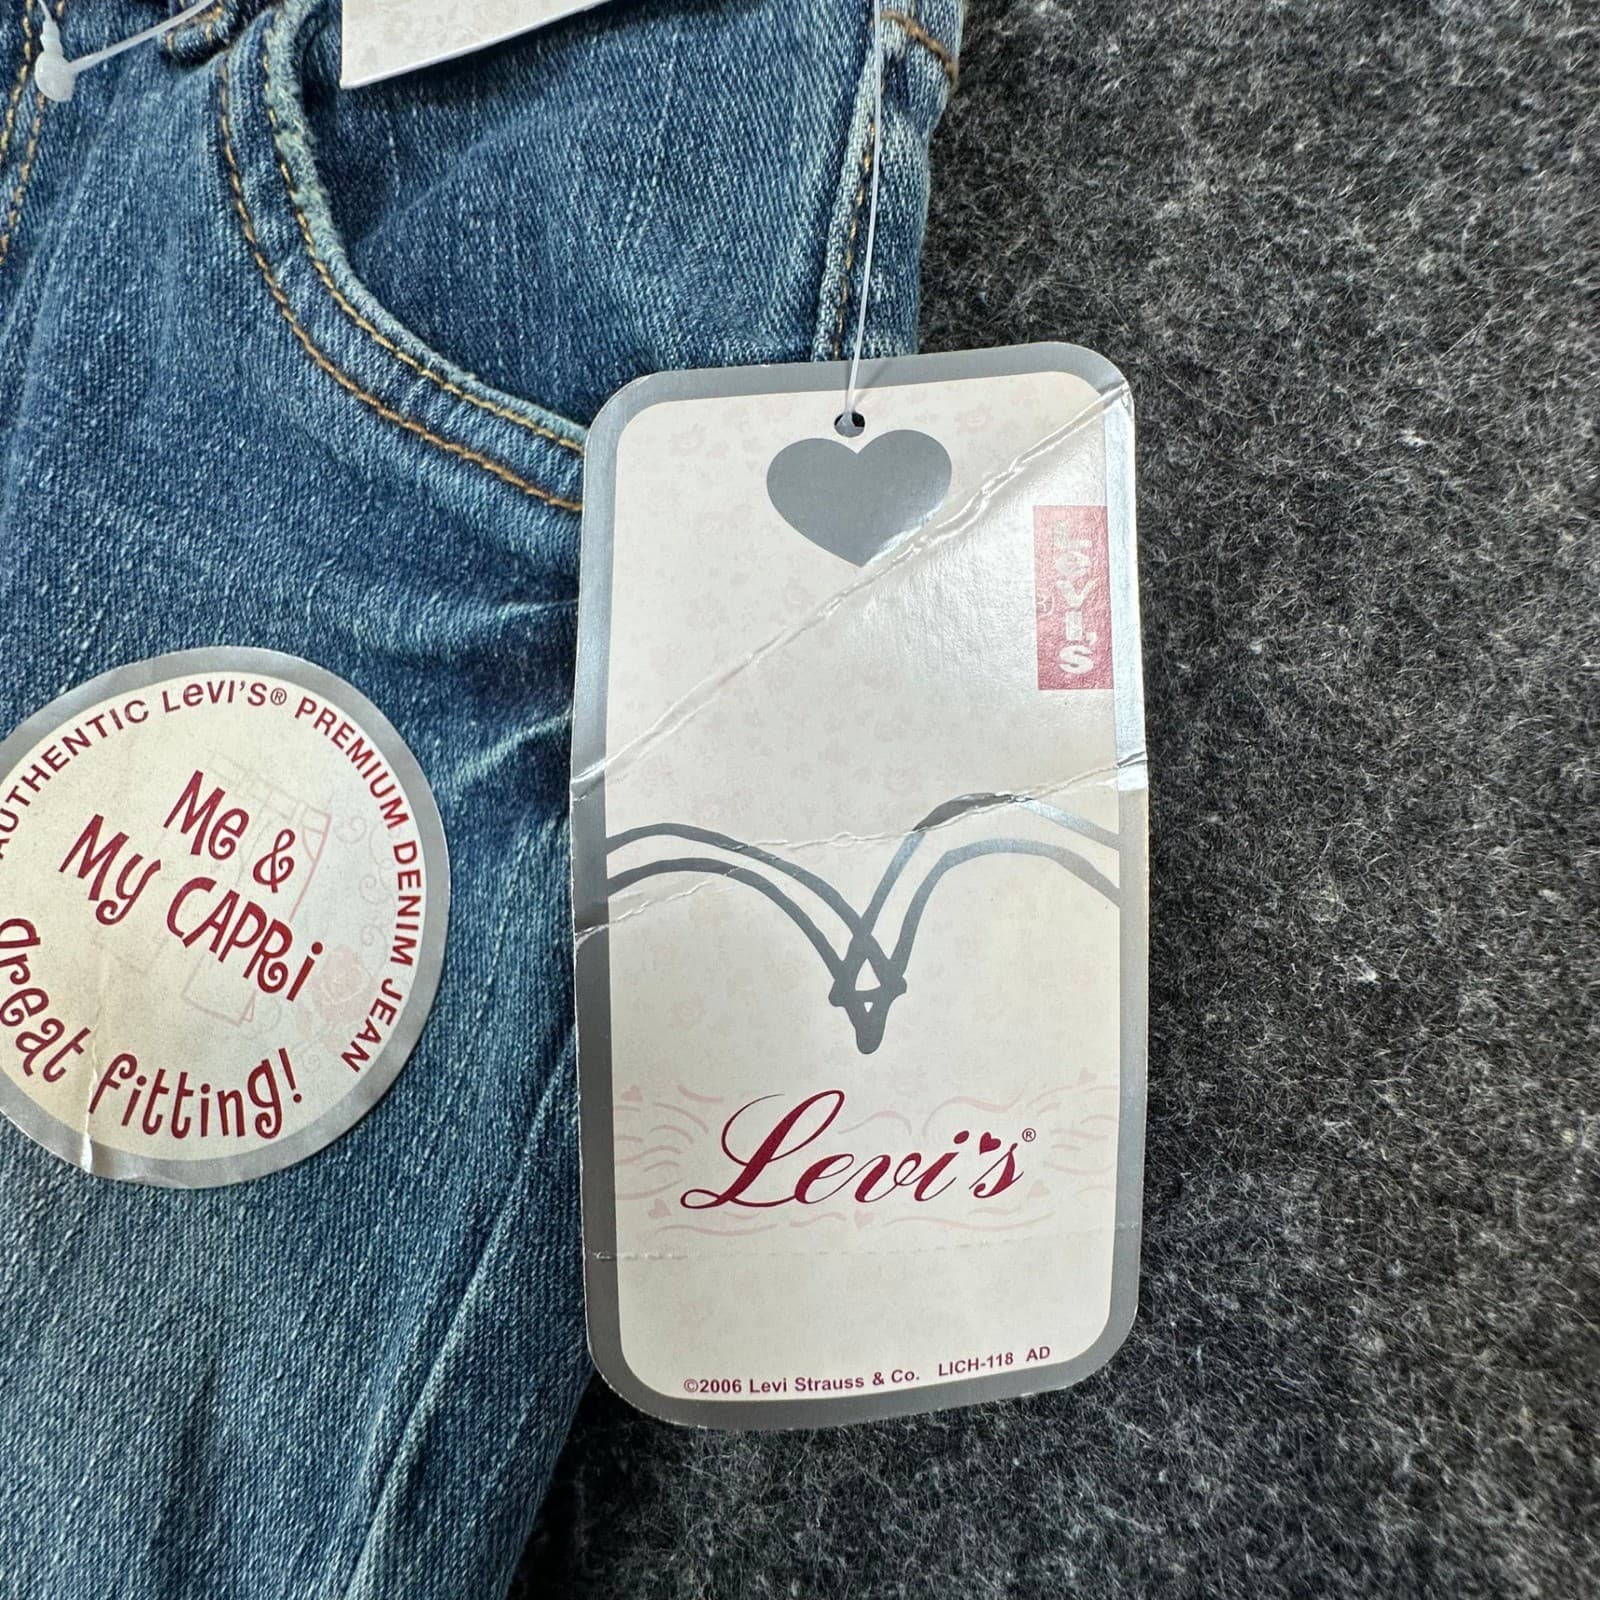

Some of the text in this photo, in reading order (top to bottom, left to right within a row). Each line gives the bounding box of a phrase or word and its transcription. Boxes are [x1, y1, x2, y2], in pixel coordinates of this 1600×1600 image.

[294, 696, 410, 830] PREMIUM
[59, 813, 161, 926] My
[251, 828, 297, 894] &
[388, 839, 422, 967] DENIM
[340, 977, 403, 1073] JEAN
[683, 1345, 1051, 1395] ©2006 Levi Strauss & Co. LICH-118 AD
